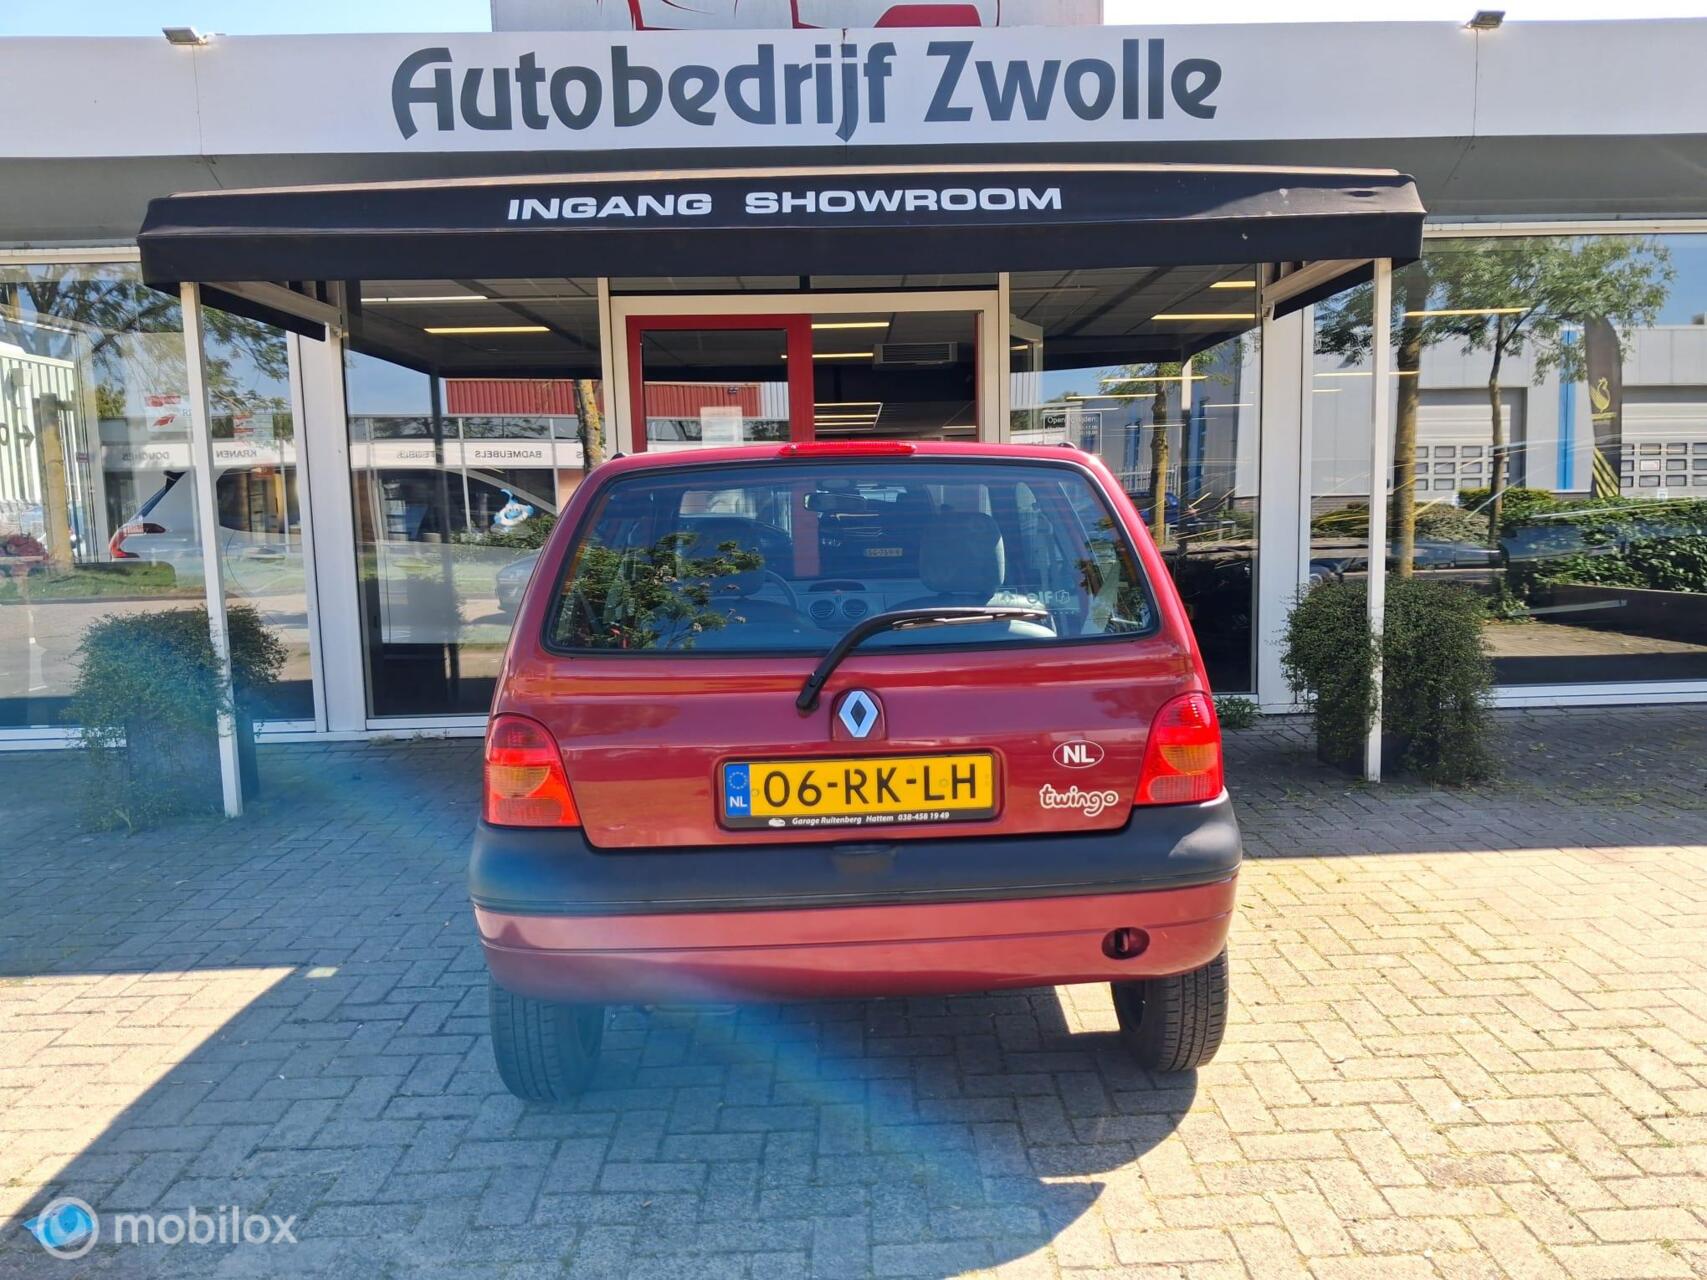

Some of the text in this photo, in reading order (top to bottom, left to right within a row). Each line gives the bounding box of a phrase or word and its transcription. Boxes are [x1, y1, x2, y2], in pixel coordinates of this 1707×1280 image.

[392, 39, 1222, 145] Autobedrijf Zwolle
[507, 187, 1062, 221] INGANG SHOWROOM
[1063, 744, 1096, 764] NL
[729, 796, 748, 808] NL
[763, 763, 977, 807] 06-RK-LH
[1039, 783, 1119, 817] twingo
[792, 811, 950, 826] Garage Ruitenberg Hattem 038-458 19 49
